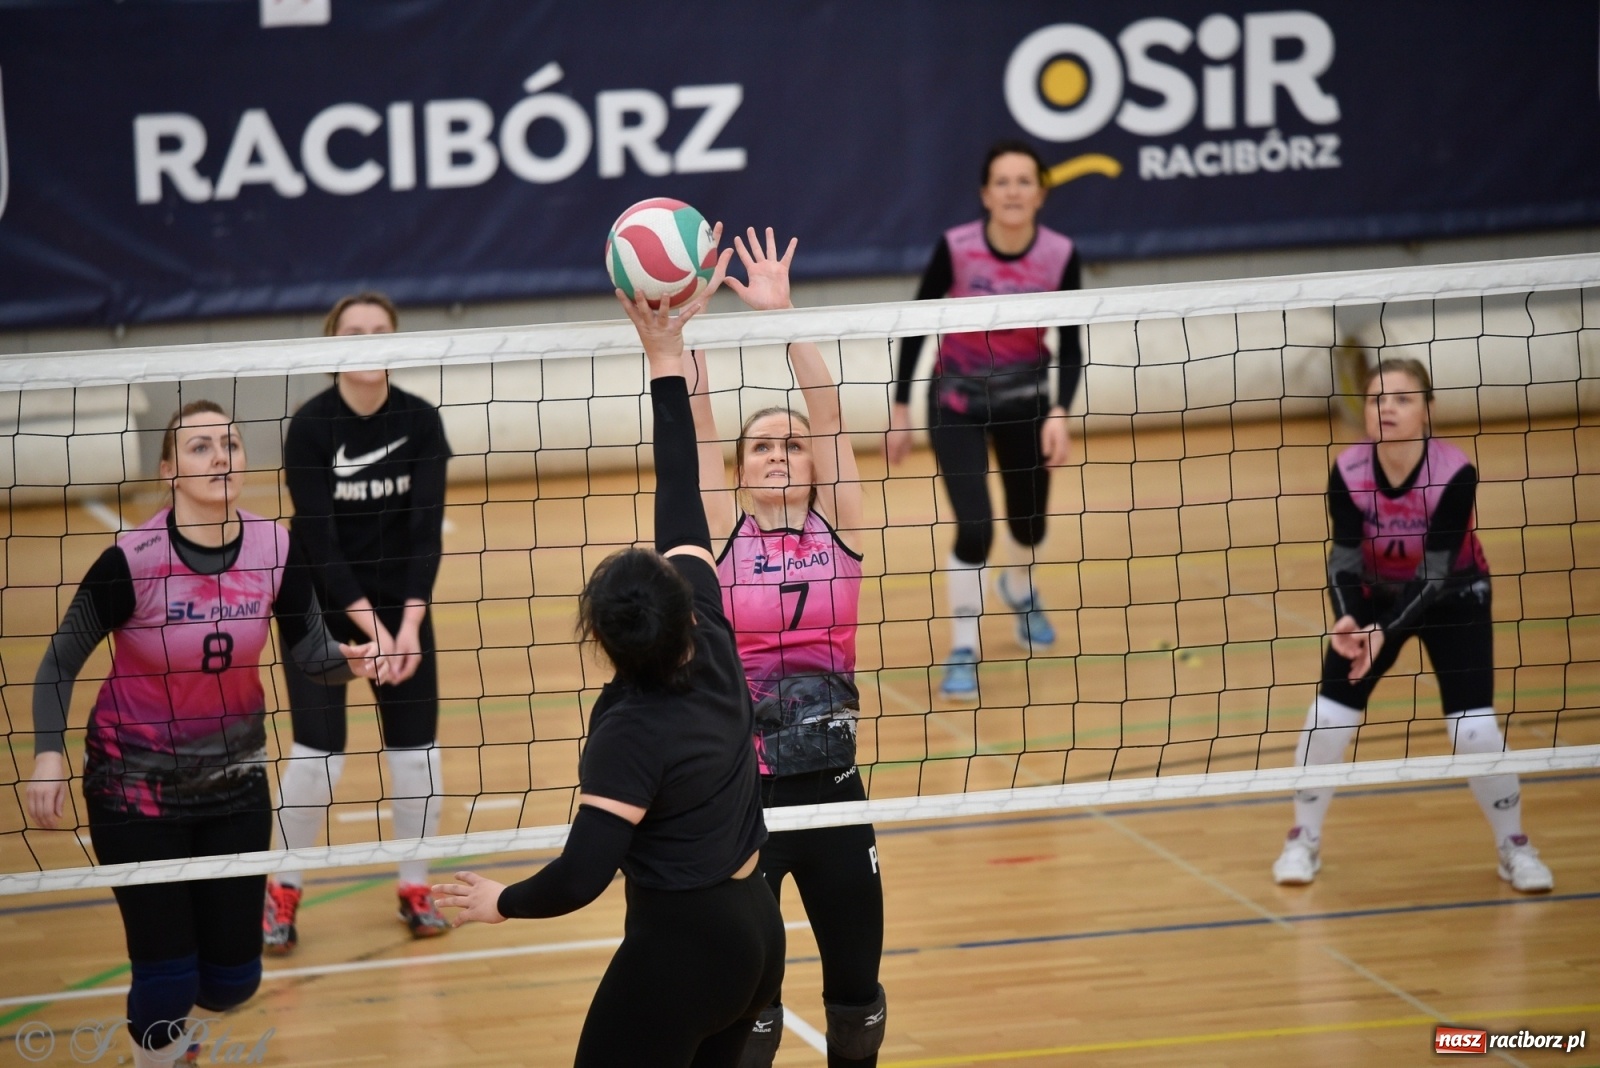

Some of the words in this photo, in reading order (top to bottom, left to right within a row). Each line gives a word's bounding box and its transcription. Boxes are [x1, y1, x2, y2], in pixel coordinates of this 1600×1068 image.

[133, 61, 747, 204] RACIBÓRZ
[1138, 130, 1341, 180] RACIBÓRZ
[333, 480, 369, 501] JUST
[370, 478, 394, 499] DO
[168, 601, 205, 621] SL
[210, 601, 261, 620] POLAND
[781, 583, 809, 631] 7
[202, 632, 233, 674] 8
